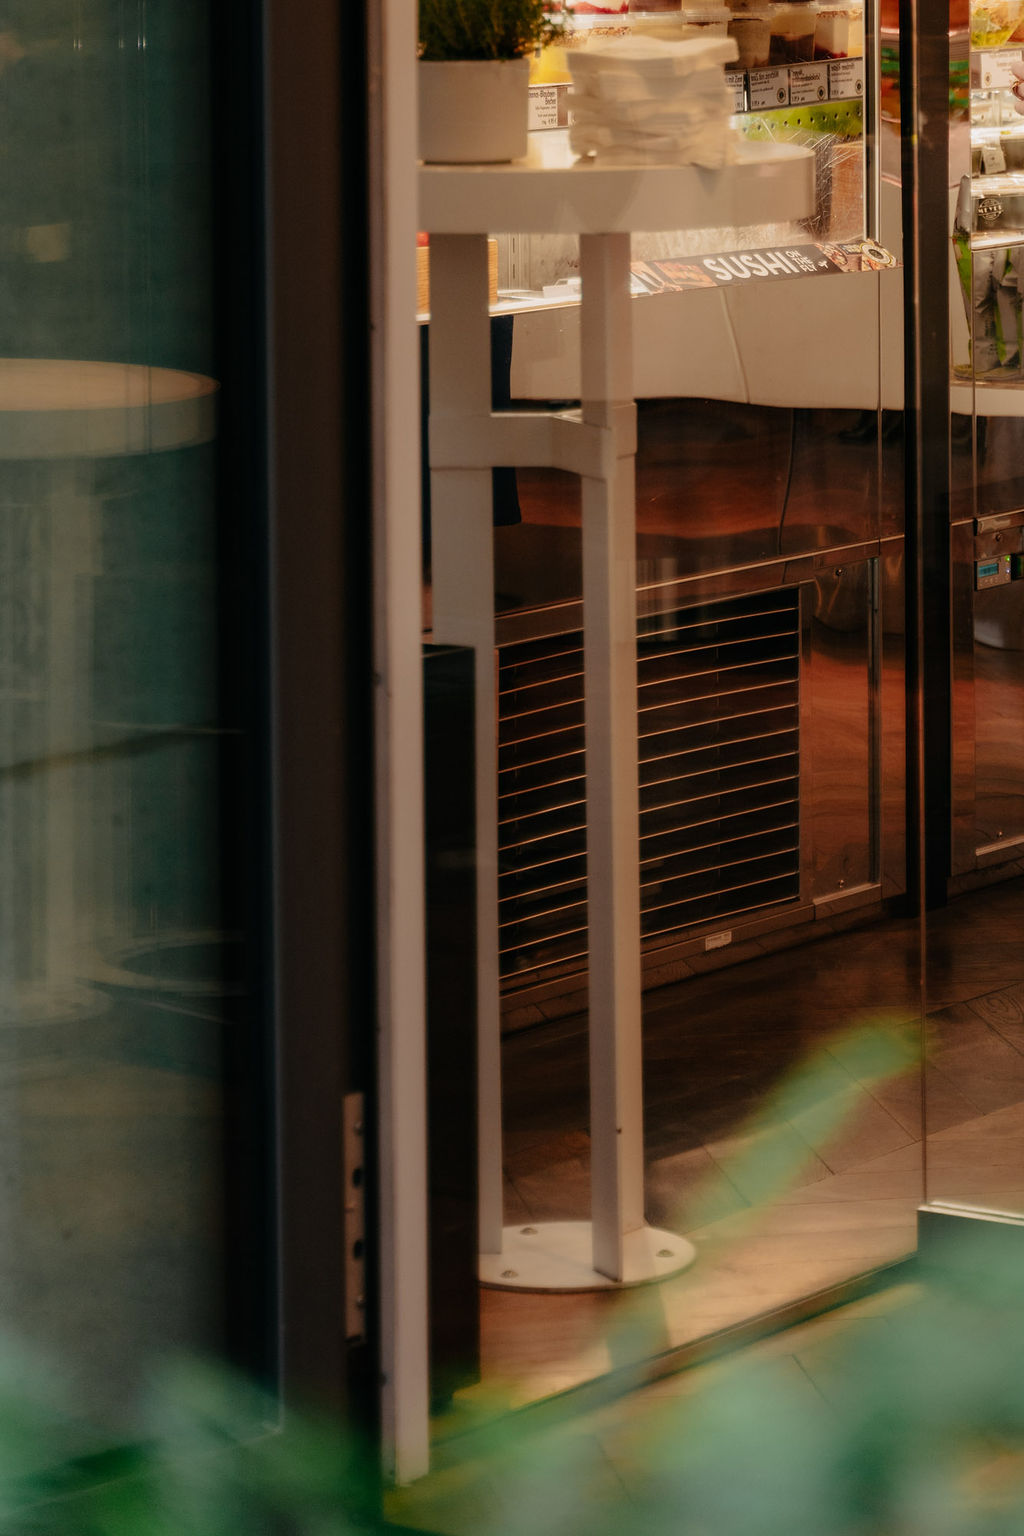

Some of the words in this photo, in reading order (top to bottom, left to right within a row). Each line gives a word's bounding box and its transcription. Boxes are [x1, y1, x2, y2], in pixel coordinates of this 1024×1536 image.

[792, 256, 813, 265] THE
[703, 251, 800, 281] SUSHI
[799, 264, 818, 273] FLY
